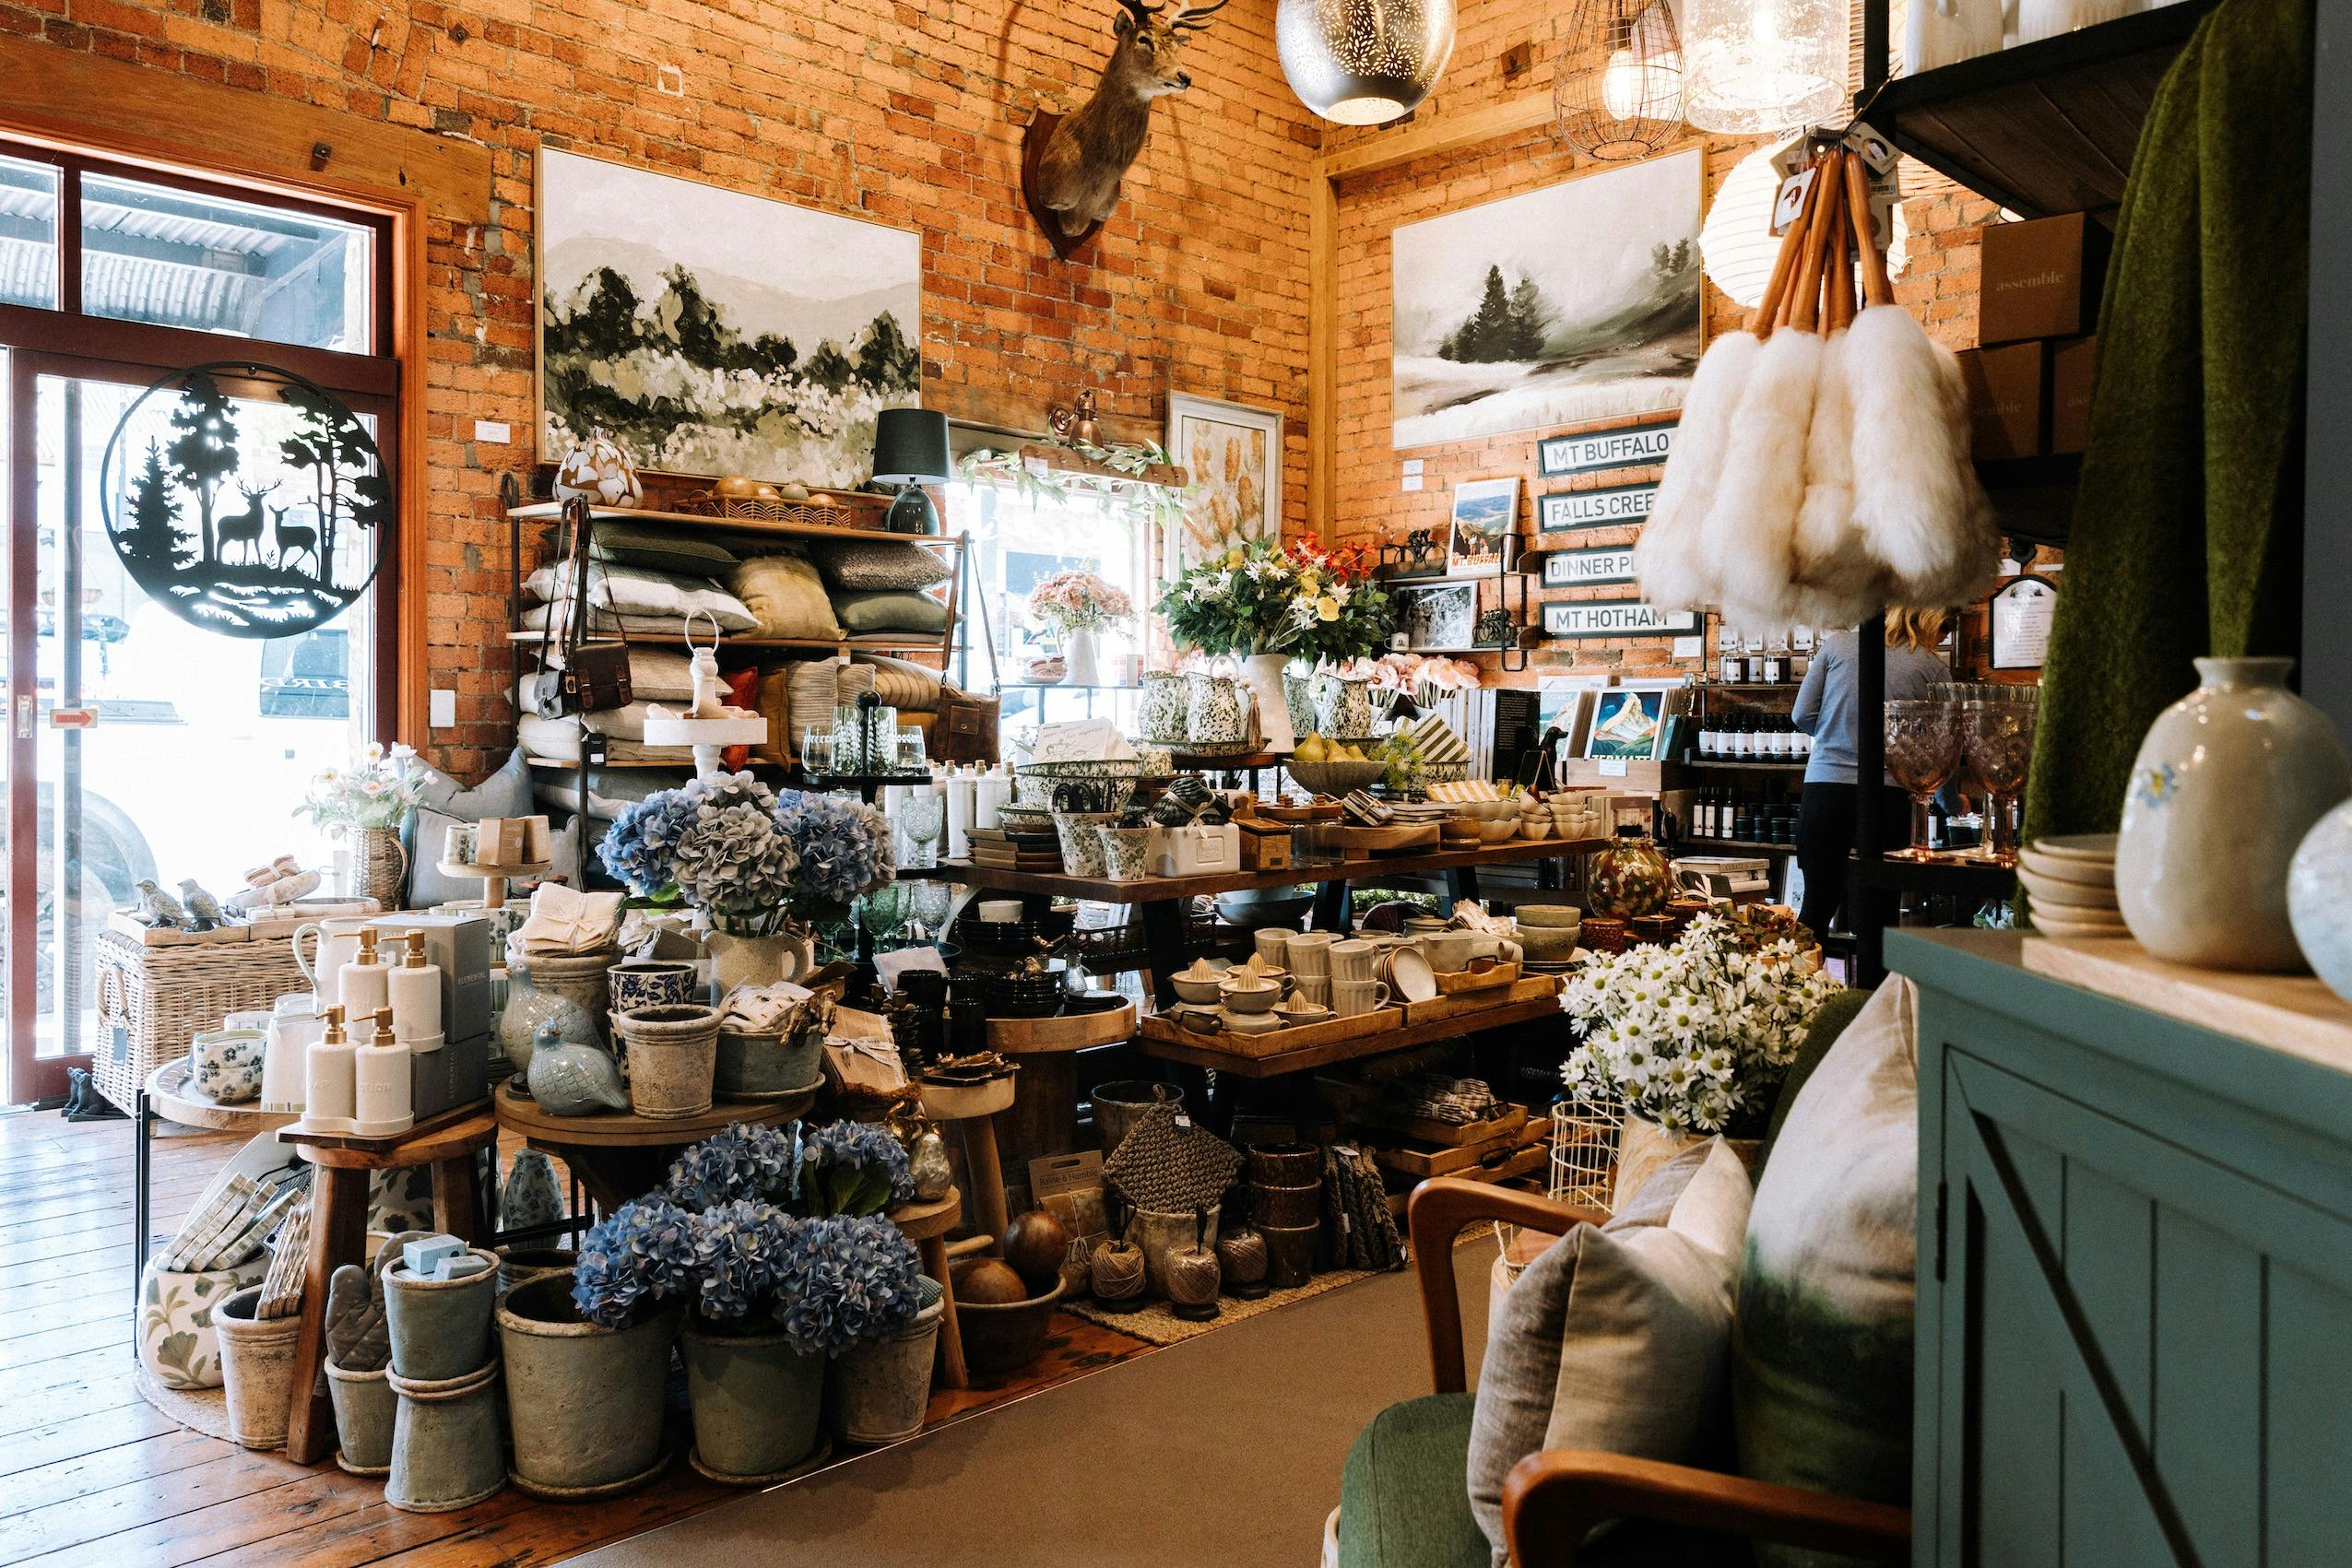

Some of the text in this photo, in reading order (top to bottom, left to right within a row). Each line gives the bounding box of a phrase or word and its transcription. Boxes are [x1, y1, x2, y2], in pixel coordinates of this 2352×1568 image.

[1997, 271, 2064, 291] assemble
[1553, 433, 1669, 466] MT BUFFALO
[1552, 498, 1605, 521] FALLS
[1551, 557, 1614, 577] DINNER
[1555, 608, 1668, 629] MT HOTHAM
[457, 971, 487, 986] ELEMENTAL
[1062, 1173, 1068, 1181] &
[1070, 1169, 1098, 1181] Humble
